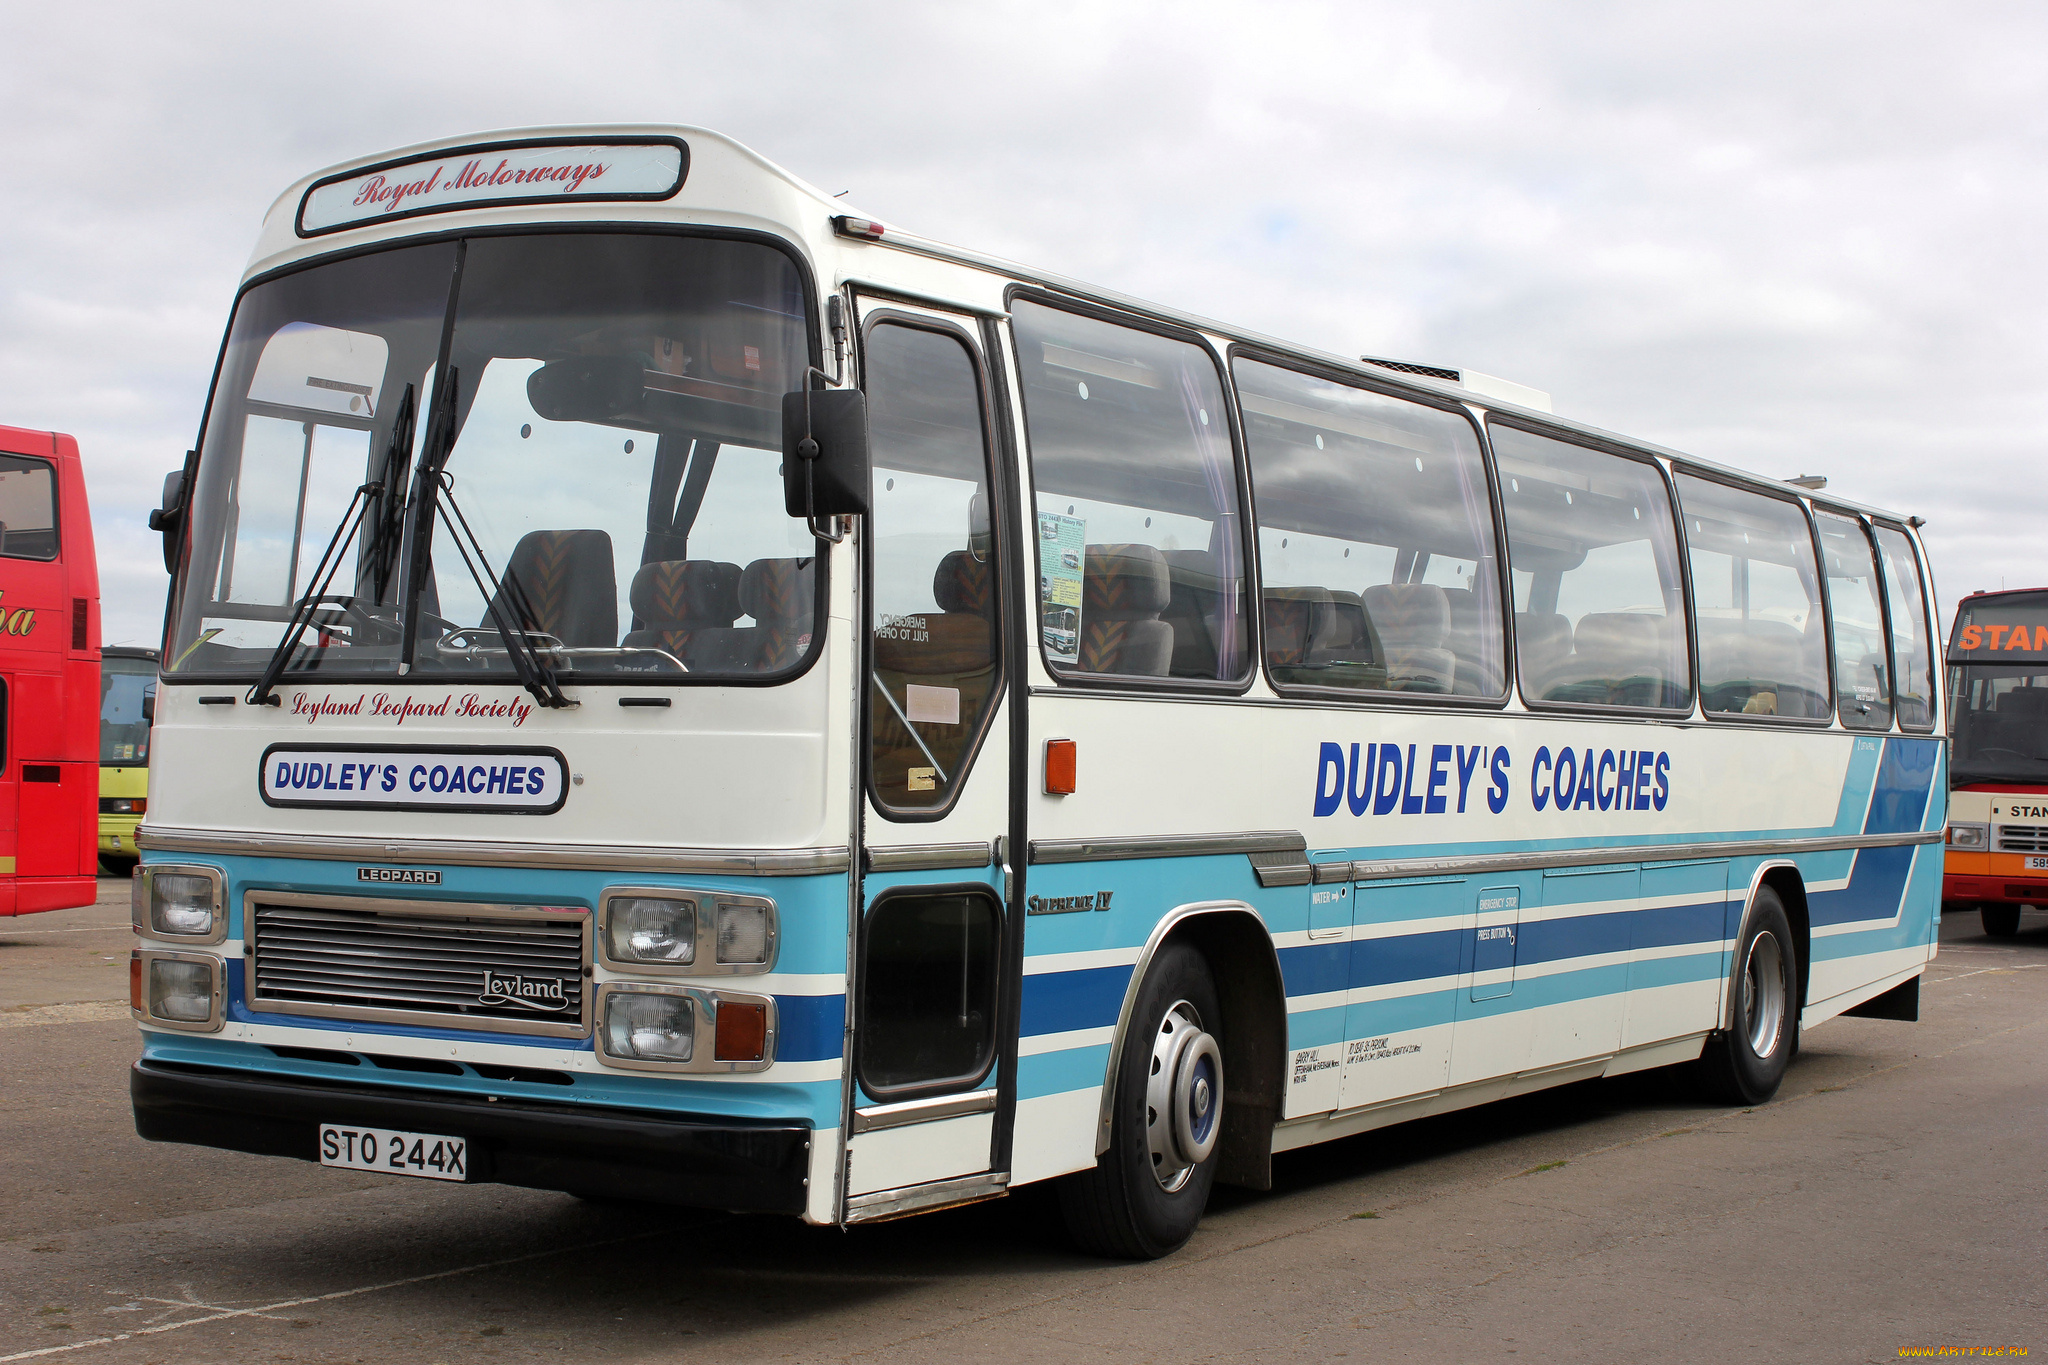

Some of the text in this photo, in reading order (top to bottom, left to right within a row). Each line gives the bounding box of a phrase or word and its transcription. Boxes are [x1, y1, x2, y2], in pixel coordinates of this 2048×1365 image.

[353, 158, 612, 212] Royal Motorways
[290, 692, 536, 728] Leyland Leopard Society
[274, 761, 546, 795] DUDLEY'S COACHES
[1313, 741, 1671, 817] DUDLEY'S COACHES
[361, 869, 437, 884] LEOPARD
[1312, 891, 1331, 905] WATER
[1480, 898, 1505, 910] EMERGENCY
[1478, 927, 1507, 941] PRESS BUTTON
[479, 970, 568, 1009] Leyland
[323, 1128, 464, 1175] STO 244X
